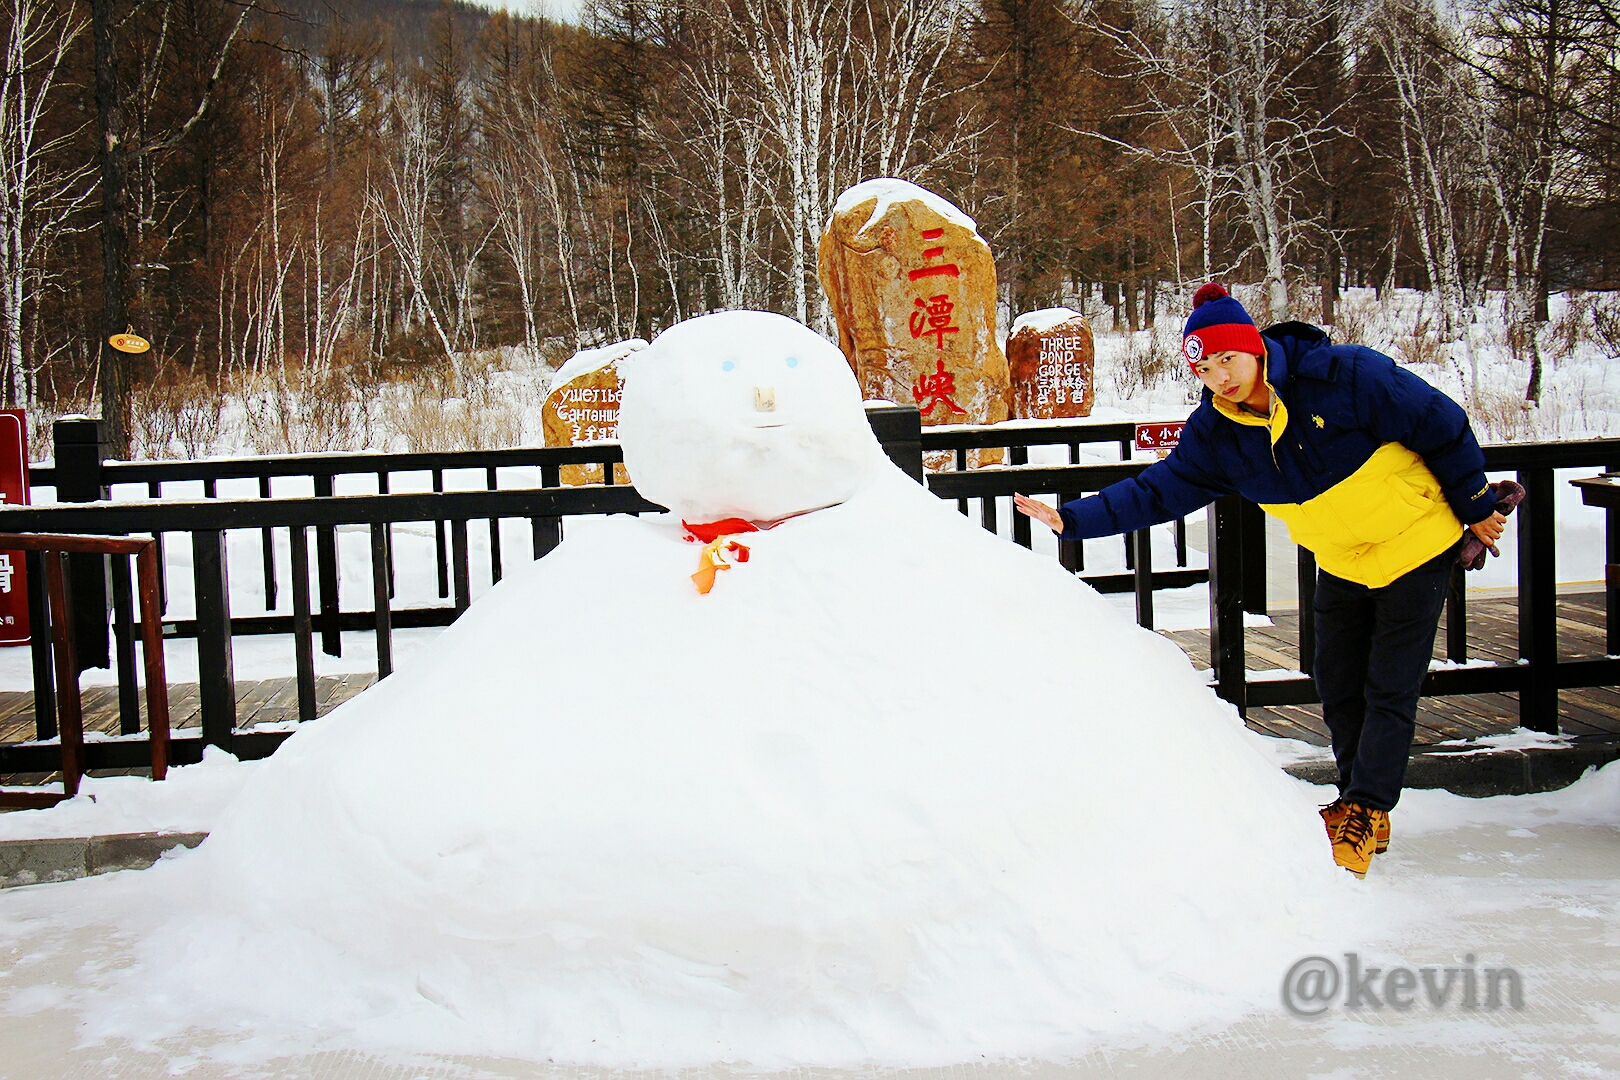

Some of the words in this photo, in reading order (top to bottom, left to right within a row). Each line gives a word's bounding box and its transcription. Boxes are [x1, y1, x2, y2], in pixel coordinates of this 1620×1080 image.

[908, 227, 966, 415] 三潭峡
[1040, 337, 1082, 352] THREE
[1040, 350, 1074, 364] POND
[1038, 363, 1081, 377] GORGE
